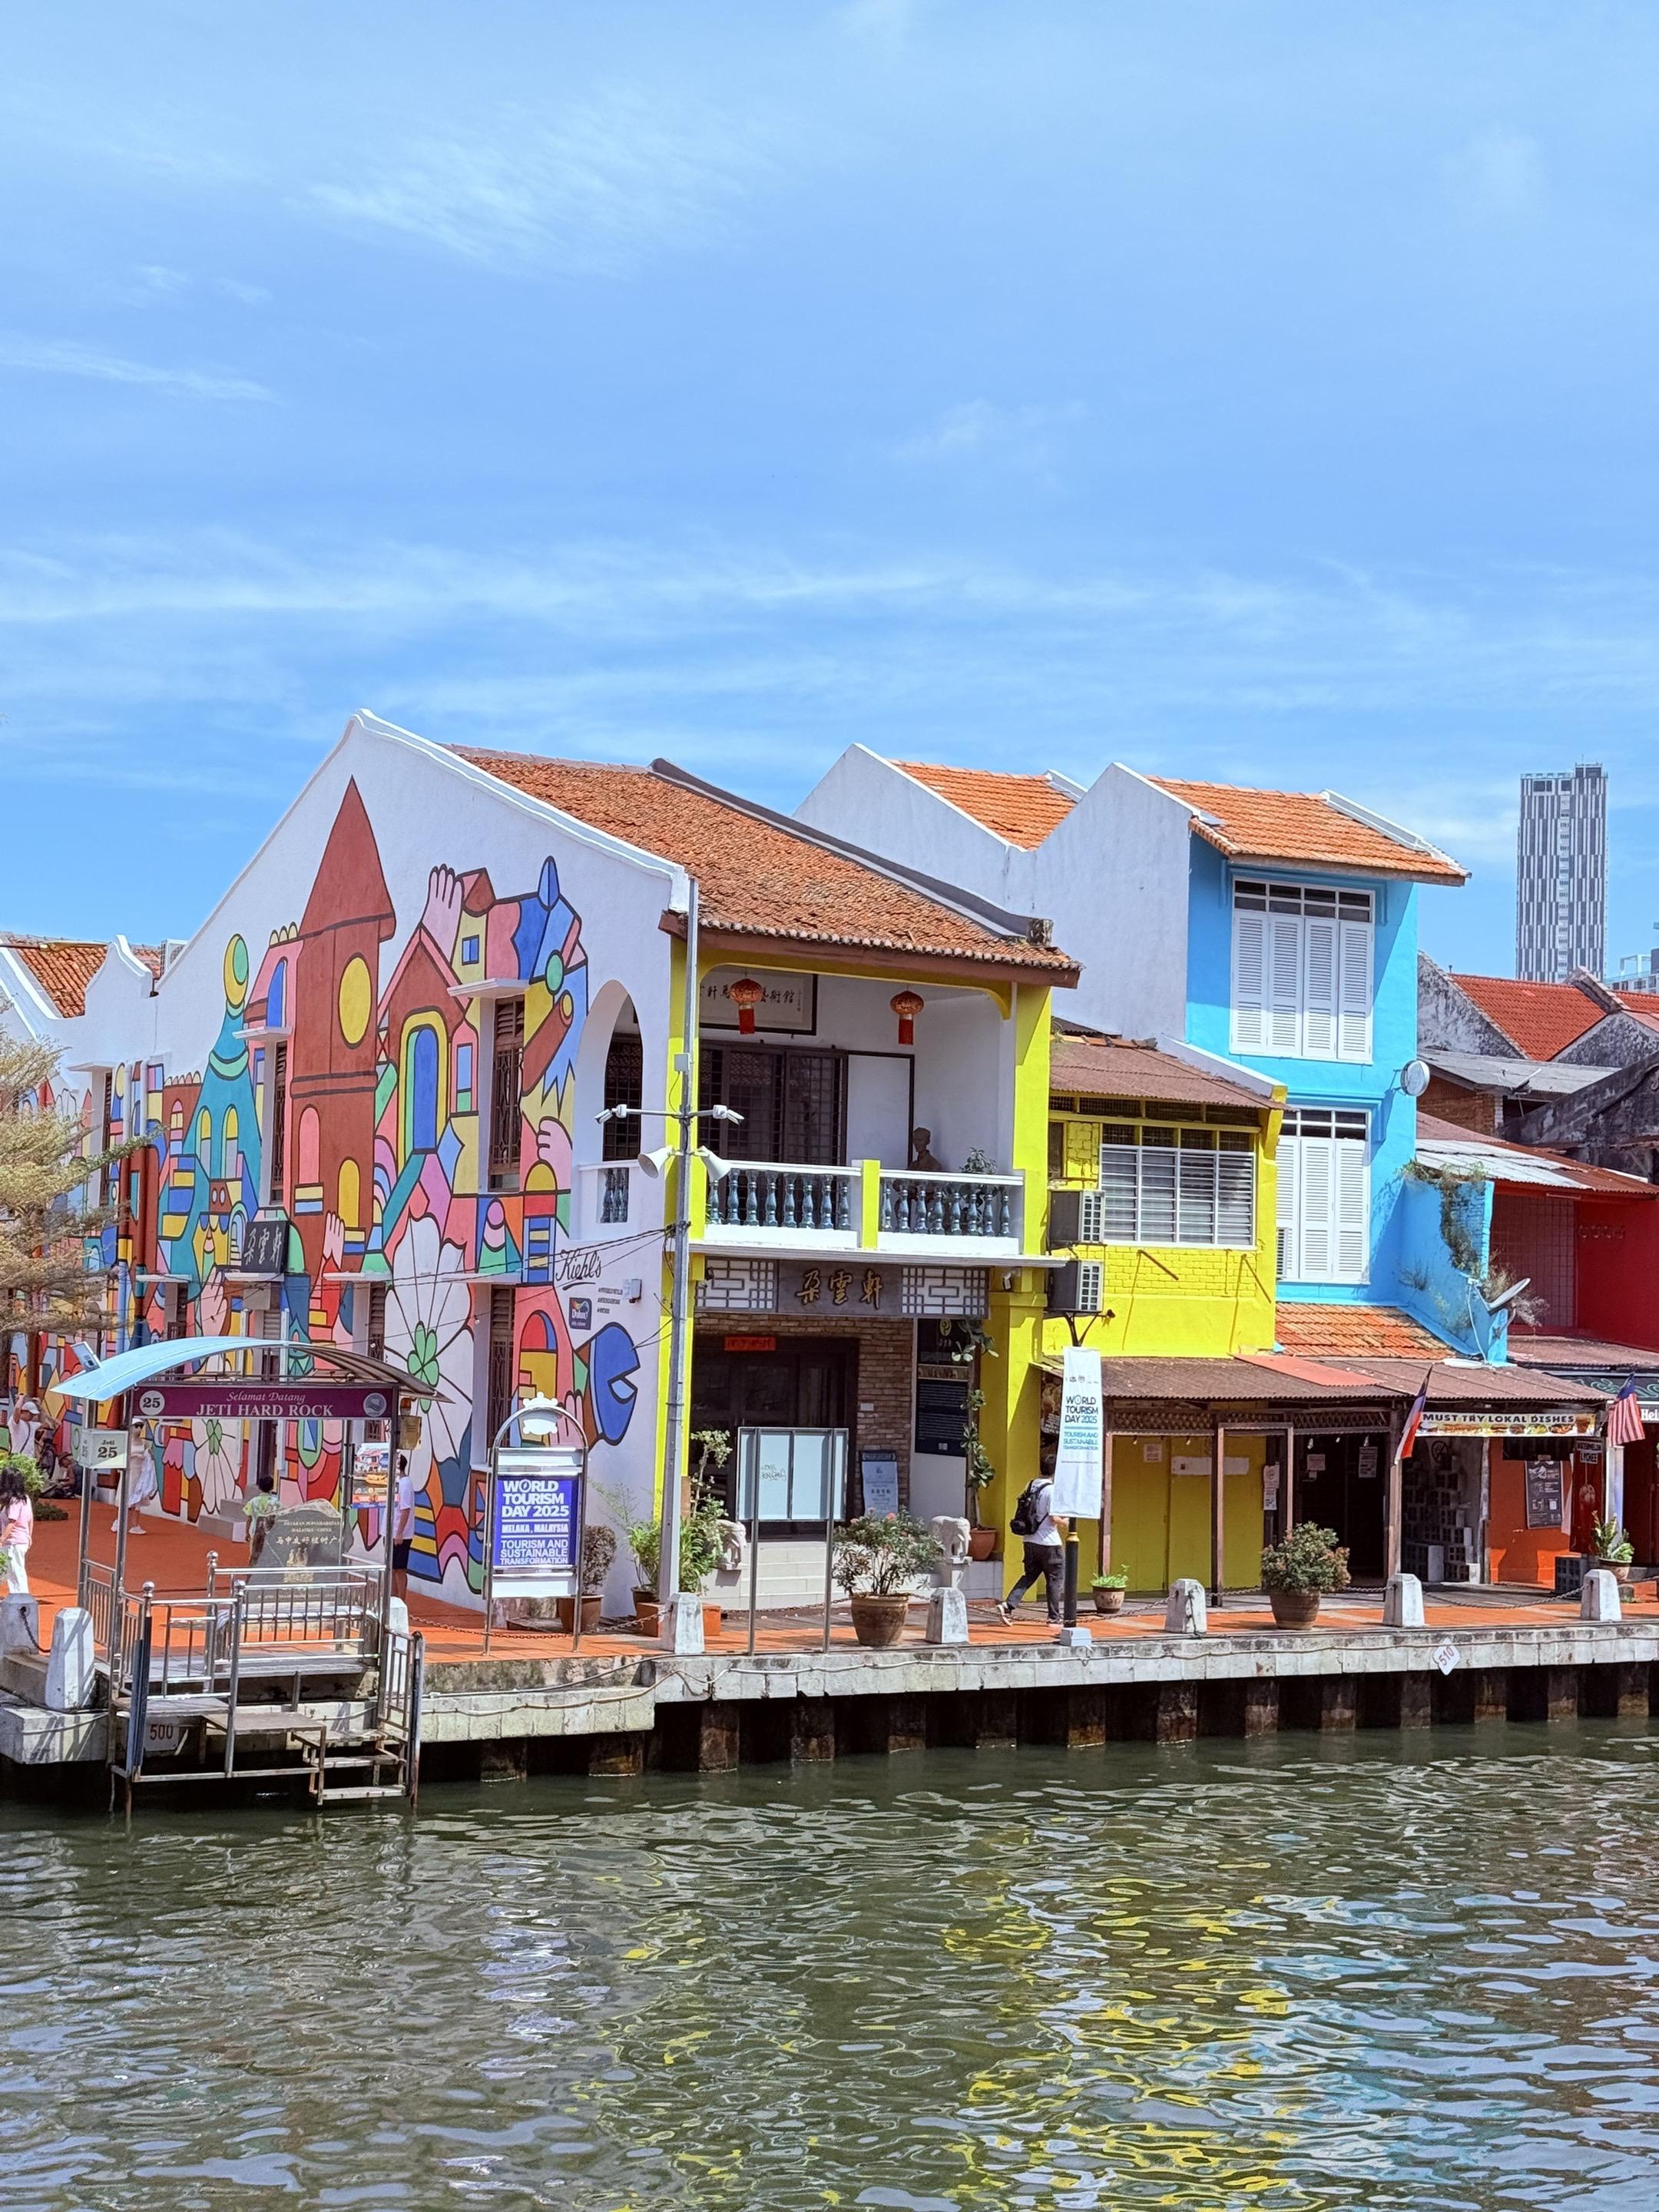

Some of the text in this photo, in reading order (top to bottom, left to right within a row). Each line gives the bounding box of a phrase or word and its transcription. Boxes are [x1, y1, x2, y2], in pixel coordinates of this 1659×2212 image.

[555, 1249, 601, 1281] Kiehl's
[143, 1397, 161, 1408] 25
[227, 1391, 306, 1405] Selamat Datang
[1066, 1395, 1096, 1405] WORLD
[196, 1404, 333, 1416] JETI HARD ROCK
[1065, 1406, 1098, 1415] TOURISM
[1065, 1415, 1080, 1423] DAY
[1081, 1416, 1098, 1424] 2025
[1531, 1415, 1574, 1423] DISHES
[98, 1446, 118, 1459] 25
[503, 1479, 559, 1492] WORLD
[502, 1492, 565, 1505] TOURISM
[502, 1505, 569, 1518] DAY 2025
[534, 1524, 568, 1533] MALAYSIA
[501, 1539, 568, 1549] TOURISM AND
[500, 1548, 568, 1558] SUSTAINABLE
[500, 1557, 568, 1565] TRANSFORMATION
[1439, 1646, 1454, 1666] 510
[150, 1724, 174, 1740] 500
